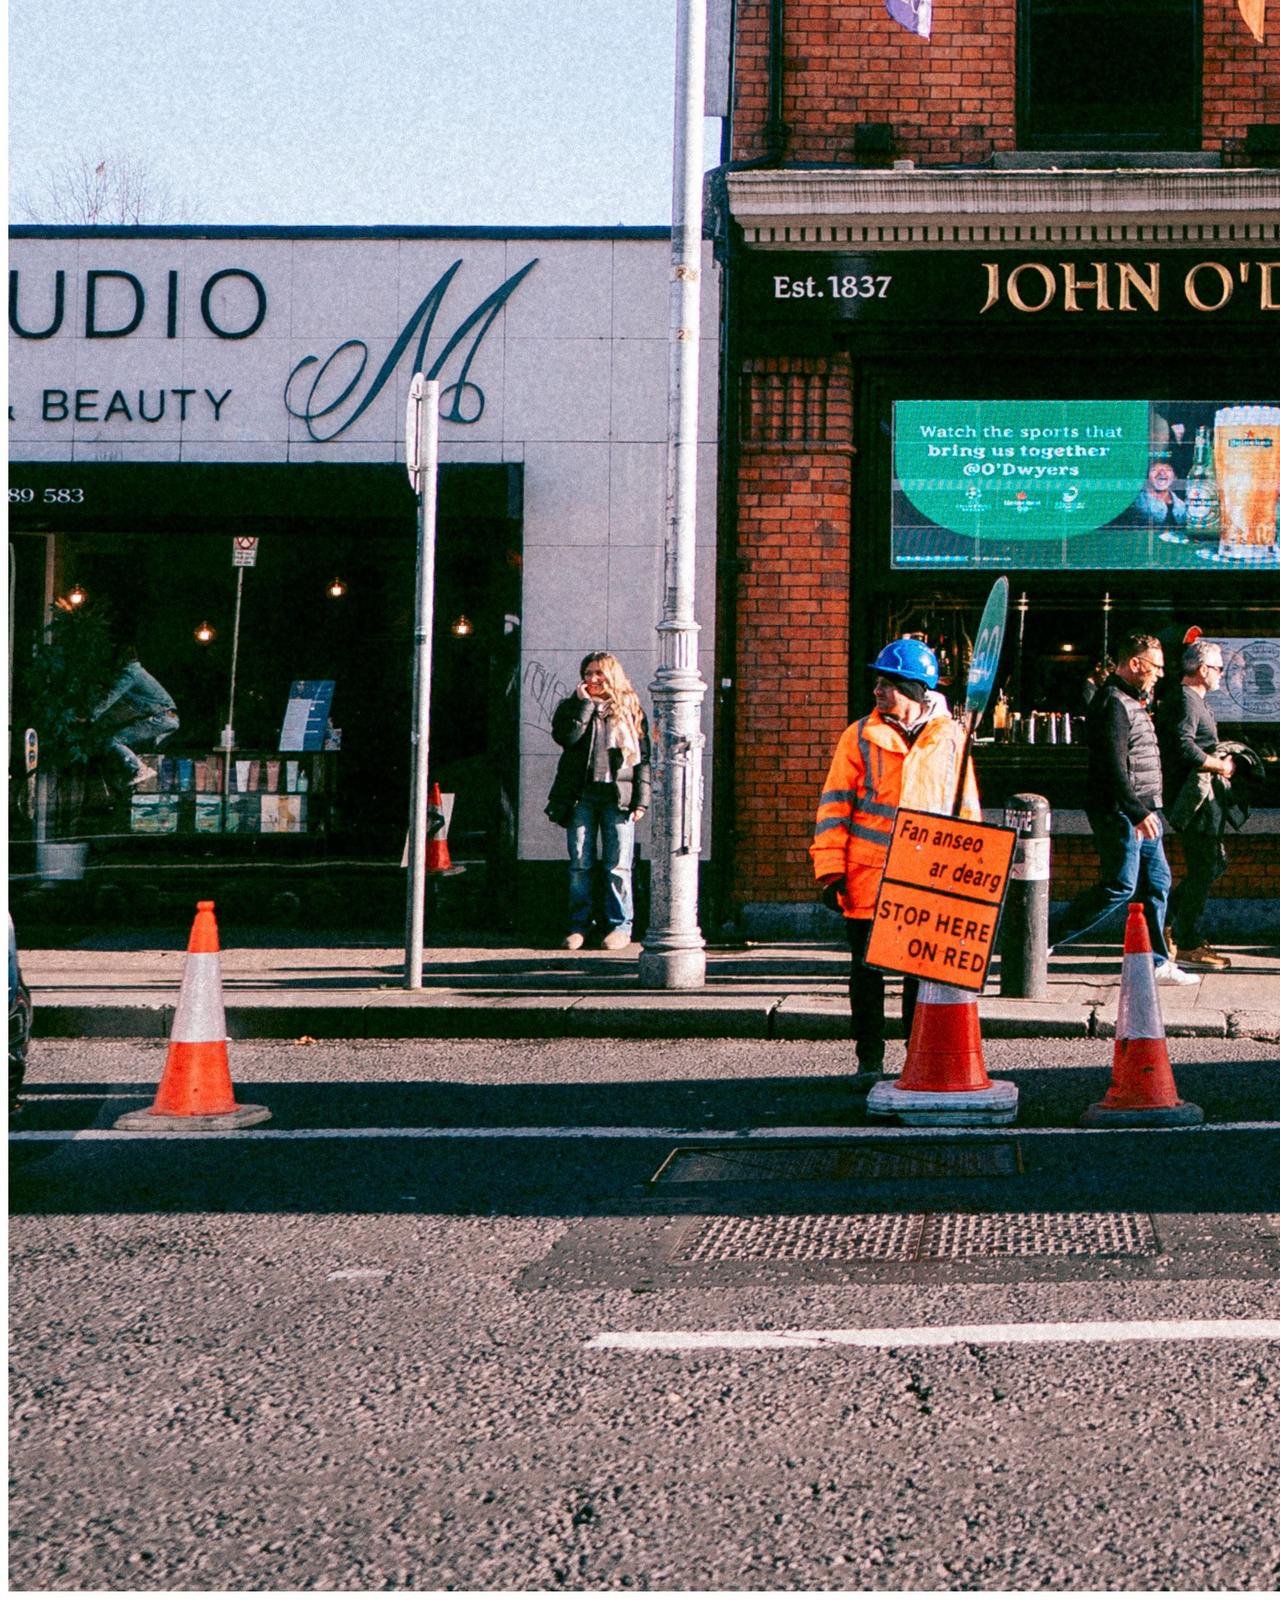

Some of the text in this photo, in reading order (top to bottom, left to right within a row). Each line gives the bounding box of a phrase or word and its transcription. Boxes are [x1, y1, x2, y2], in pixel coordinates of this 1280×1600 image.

[9, 268, 267, 340] UDIO
[980, 262, 1160, 314] JOHN
[42, 389, 233, 422] BEAUTY
[920, 425, 1123, 440] Watch the sports that
[928, 444, 1110, 460] bring us together
[963, 463, 1080, 479] @O'Dwyers
[43, 488, 85, 503] 583
[899, 819, 984, 854] Fan anseo
[929, 860, 1002, 894] ar dearg
[879, 900, 991, 944] STOP HERE
[908, 938, 985, 974] ON RED
